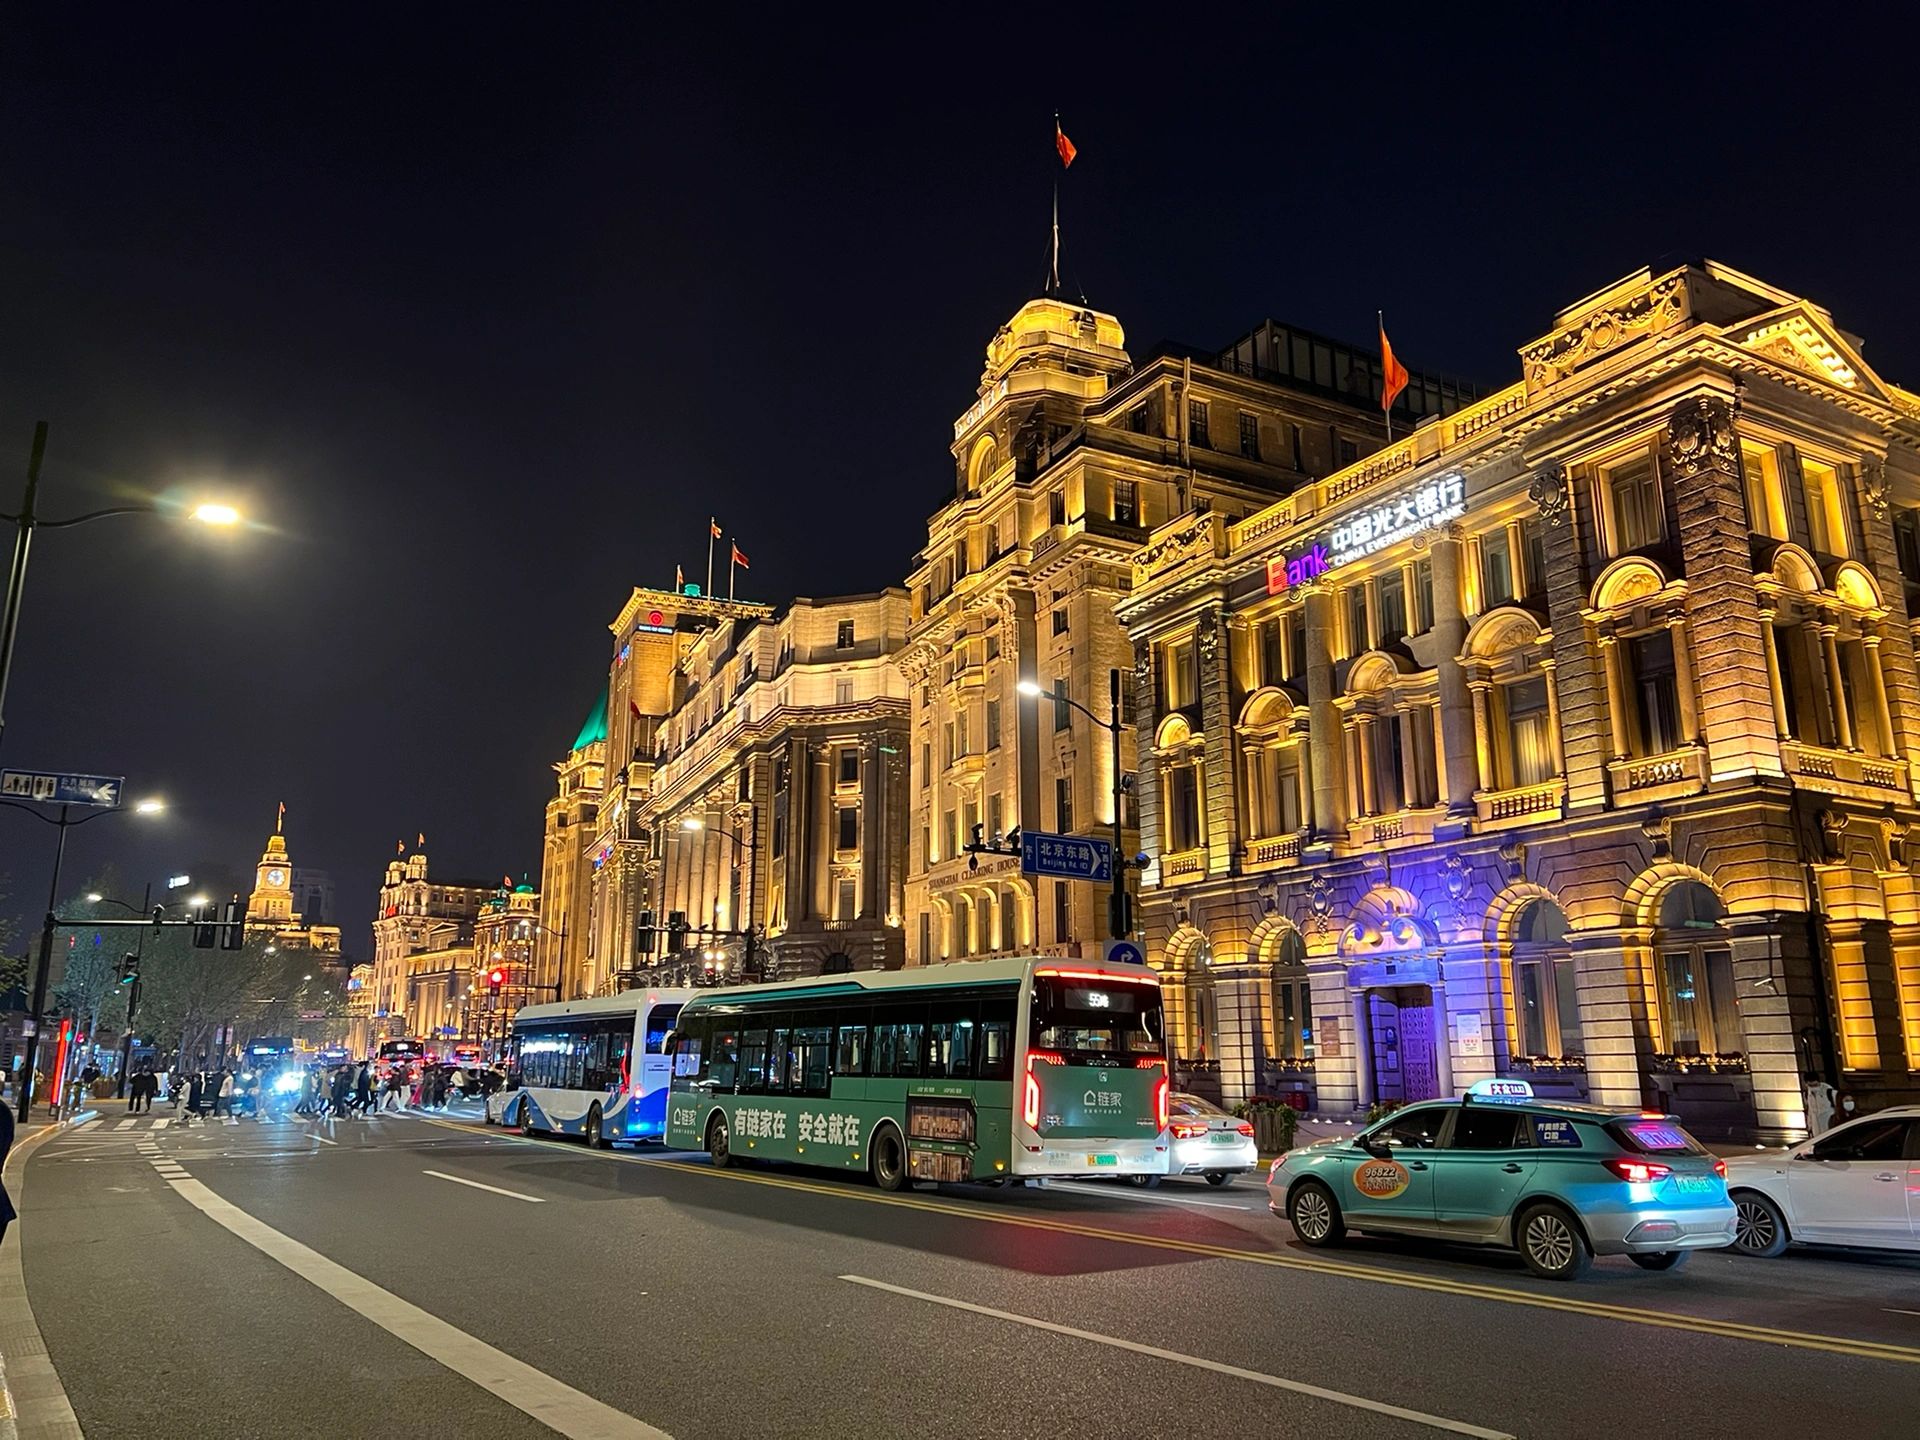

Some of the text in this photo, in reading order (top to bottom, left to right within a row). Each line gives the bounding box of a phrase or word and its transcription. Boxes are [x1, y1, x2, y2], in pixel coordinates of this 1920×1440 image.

[1333, 473, 1464, 551] 中国光大银行
[1334, 545, 1368, 566] CHINA
[1432, 503, 1465, 526] BANK
[1040, 842, 1090, 860] 北京东路
[1099, 844, 1108, 853] 27
[1042, 858, 1067, 869] Beijing
[734, 1108, 860, 1147] 有链家在 安全就在
[1365, 1167, 1396, 1177] 96822
